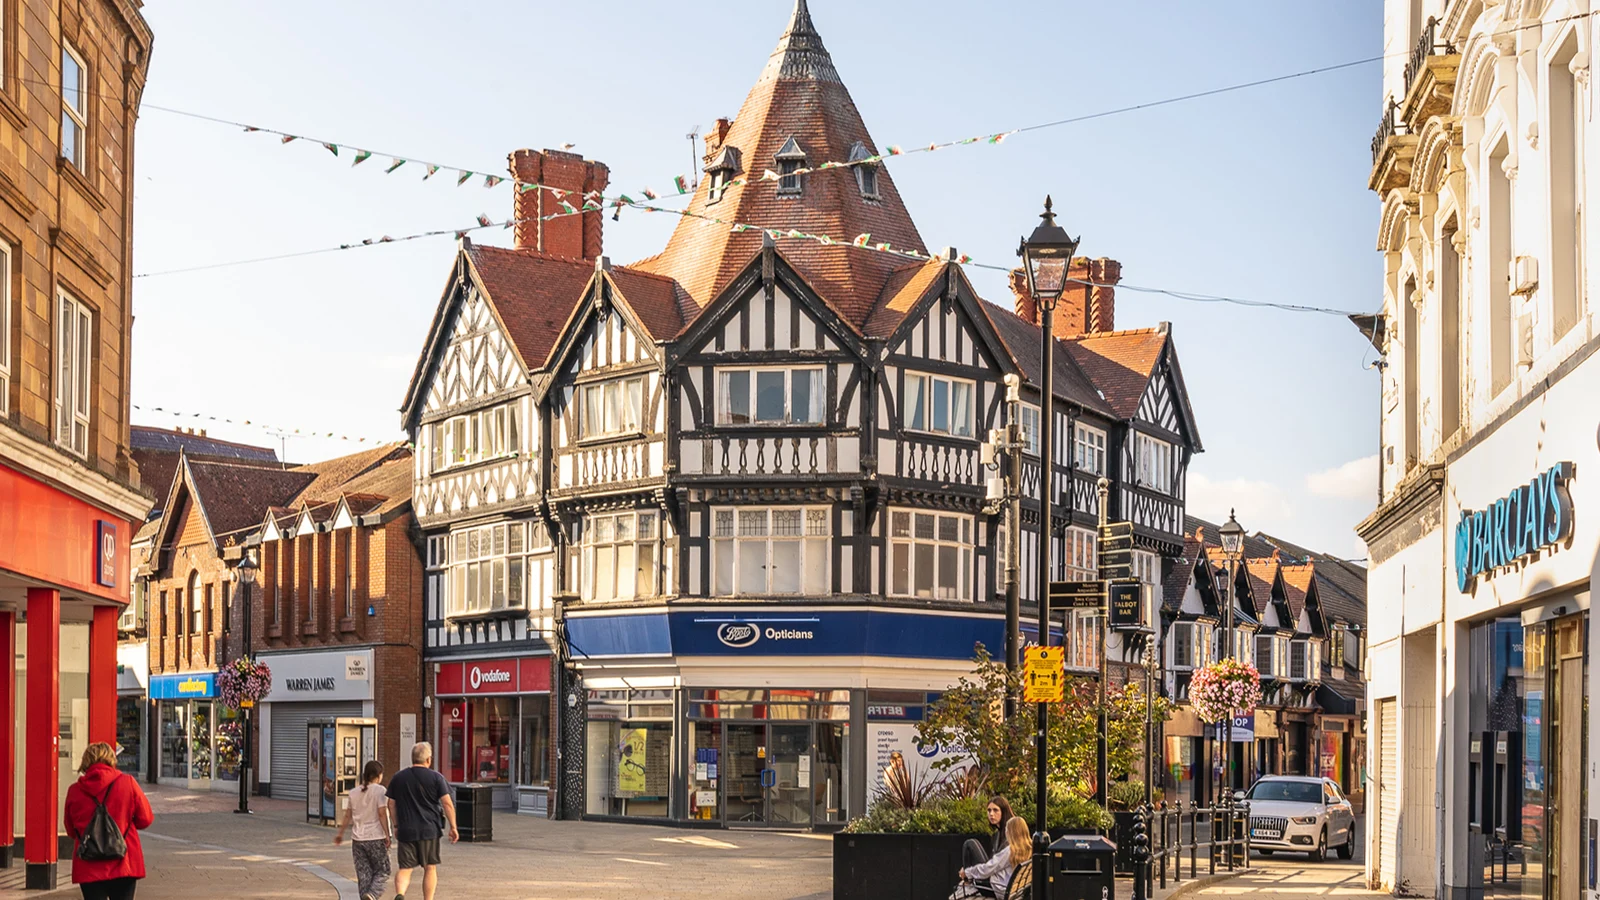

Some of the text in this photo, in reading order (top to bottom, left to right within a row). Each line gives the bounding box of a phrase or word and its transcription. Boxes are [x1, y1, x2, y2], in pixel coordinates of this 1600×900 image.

[1472, 462, 1570, 577] BARCLAYS
[104, 533, 115, 561] QD
[724, 626, 813, 641] Boots Opticians
[481, 669, 510, 683] vodafone
[286, 677, 335, 692] WARREN JAMES
